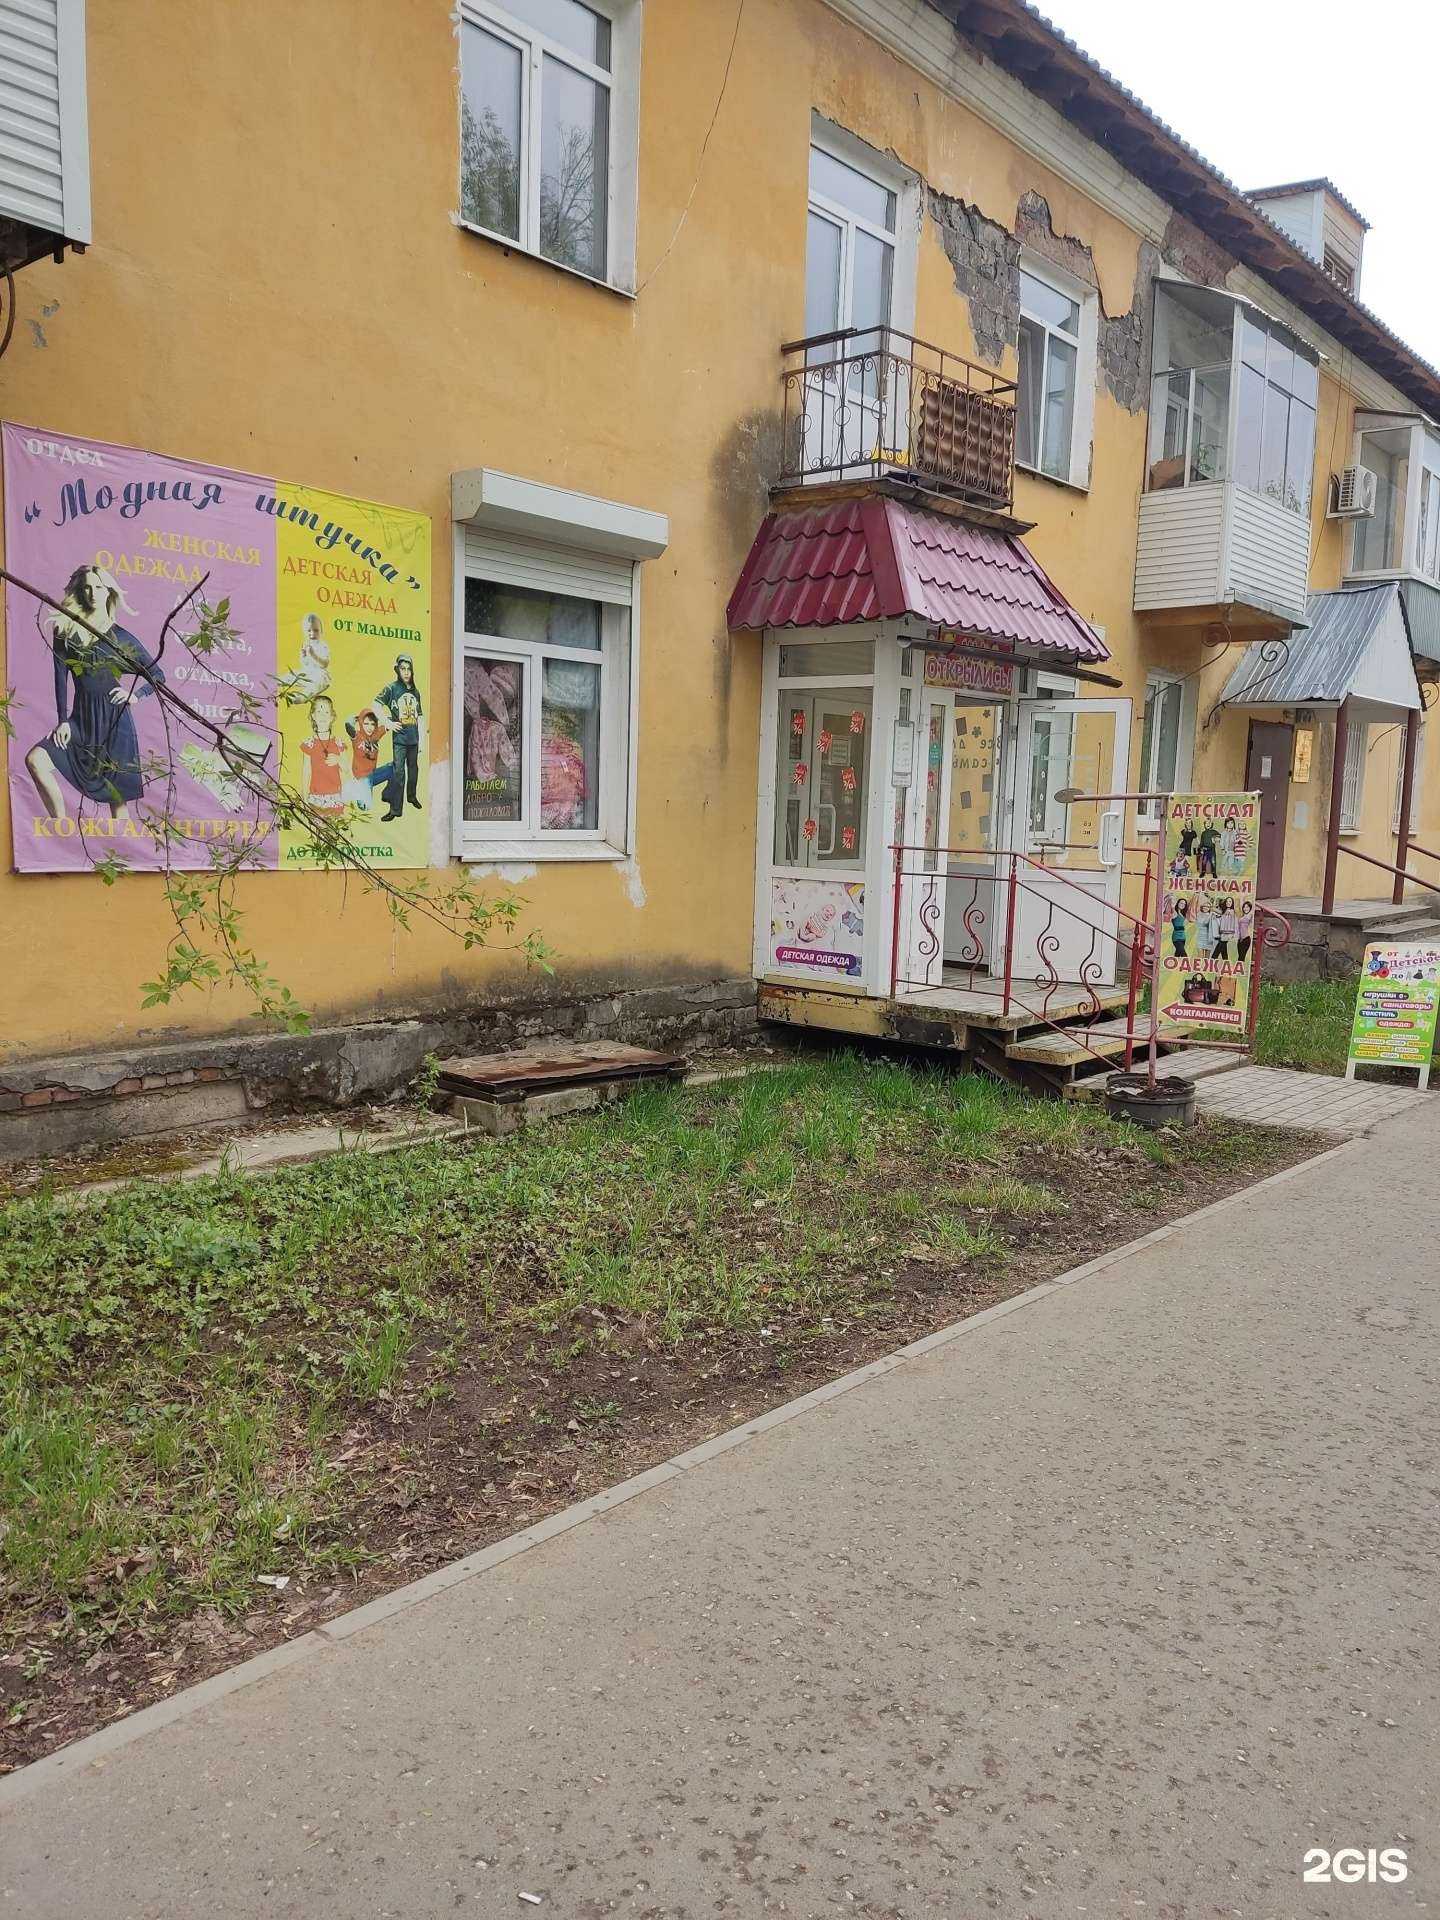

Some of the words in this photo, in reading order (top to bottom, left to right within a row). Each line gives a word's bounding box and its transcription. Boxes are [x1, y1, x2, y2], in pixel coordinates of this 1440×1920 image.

[143, 528, 262, 567] ЖЕНСКАЯ
[95, 550, 204, 585] ОДЕЖДА
[283, 555, 373, 586] ДЕТСКАЯ
[316, 586, 398, 615] ОДЕЖДА
[333, 618, 353, 632] от
[357, 622, 422, 642] малыша
[1171, 803, 1254, 819] ДЕТСКАЯ
[1168, 878, 1252, 893] ЖЕНСКАЯ
[781, 950, 815, 962] ДЕТСКАЯ
[816, 954, 850, 966] ОДЕЖДА
[1163, 956, 1245, 976] ОДЕЖДА
